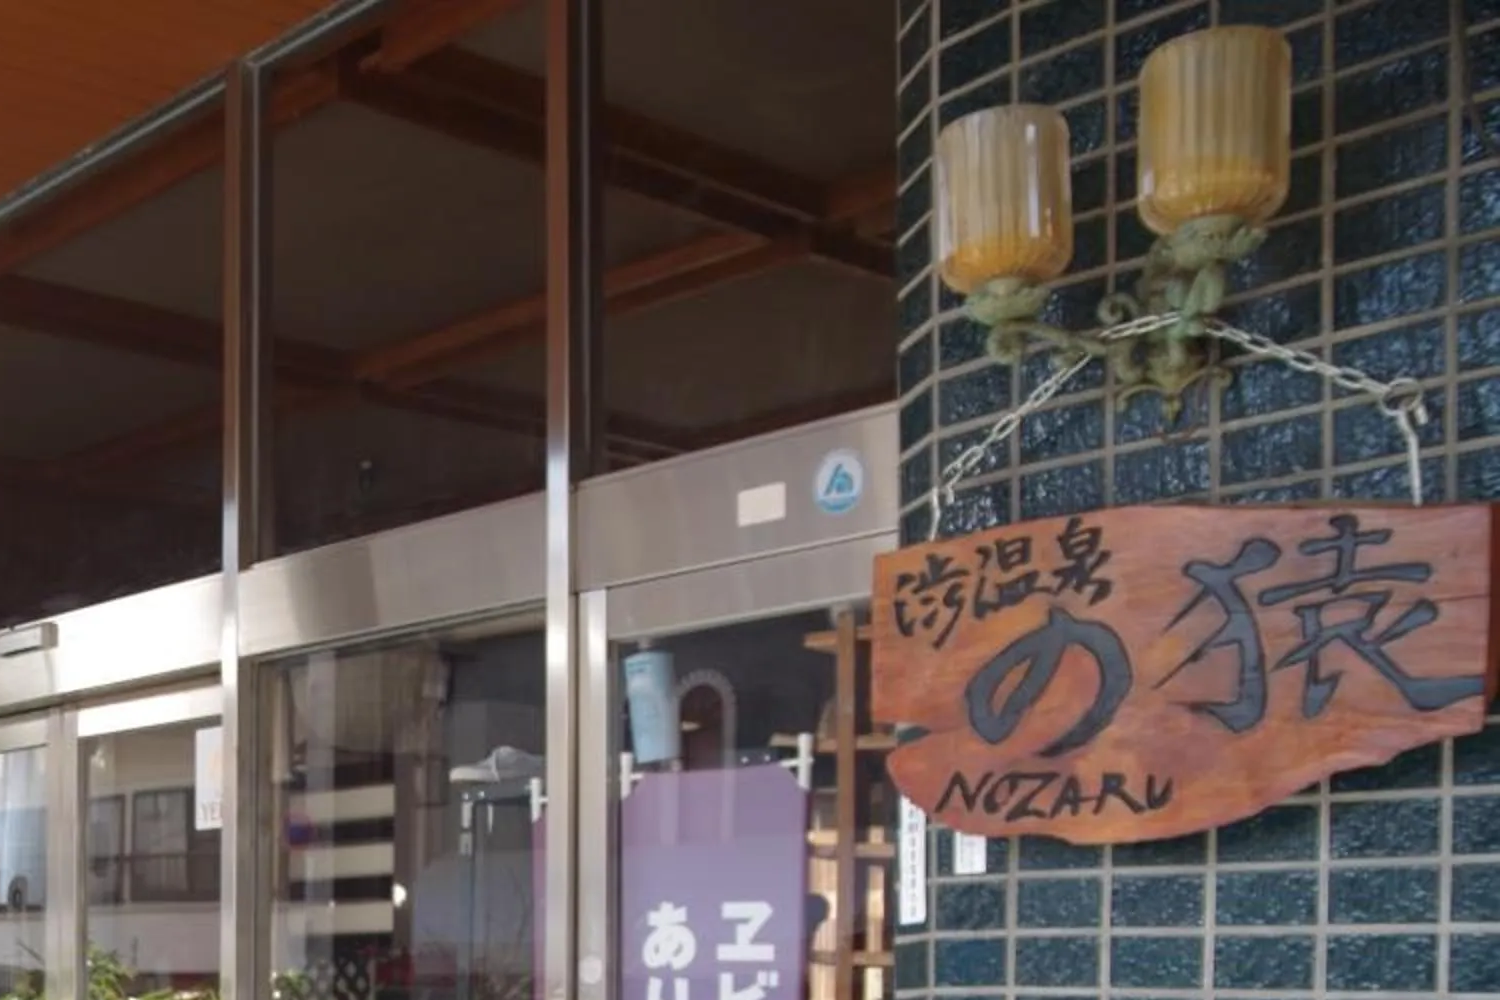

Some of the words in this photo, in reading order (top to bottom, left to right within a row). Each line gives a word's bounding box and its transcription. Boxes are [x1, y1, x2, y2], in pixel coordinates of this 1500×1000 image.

[893, 518, 1117, 649] 渋温泉
[964, 512, 1486, 758] の猿
[933, 770, 1174, 822] NOZARU
